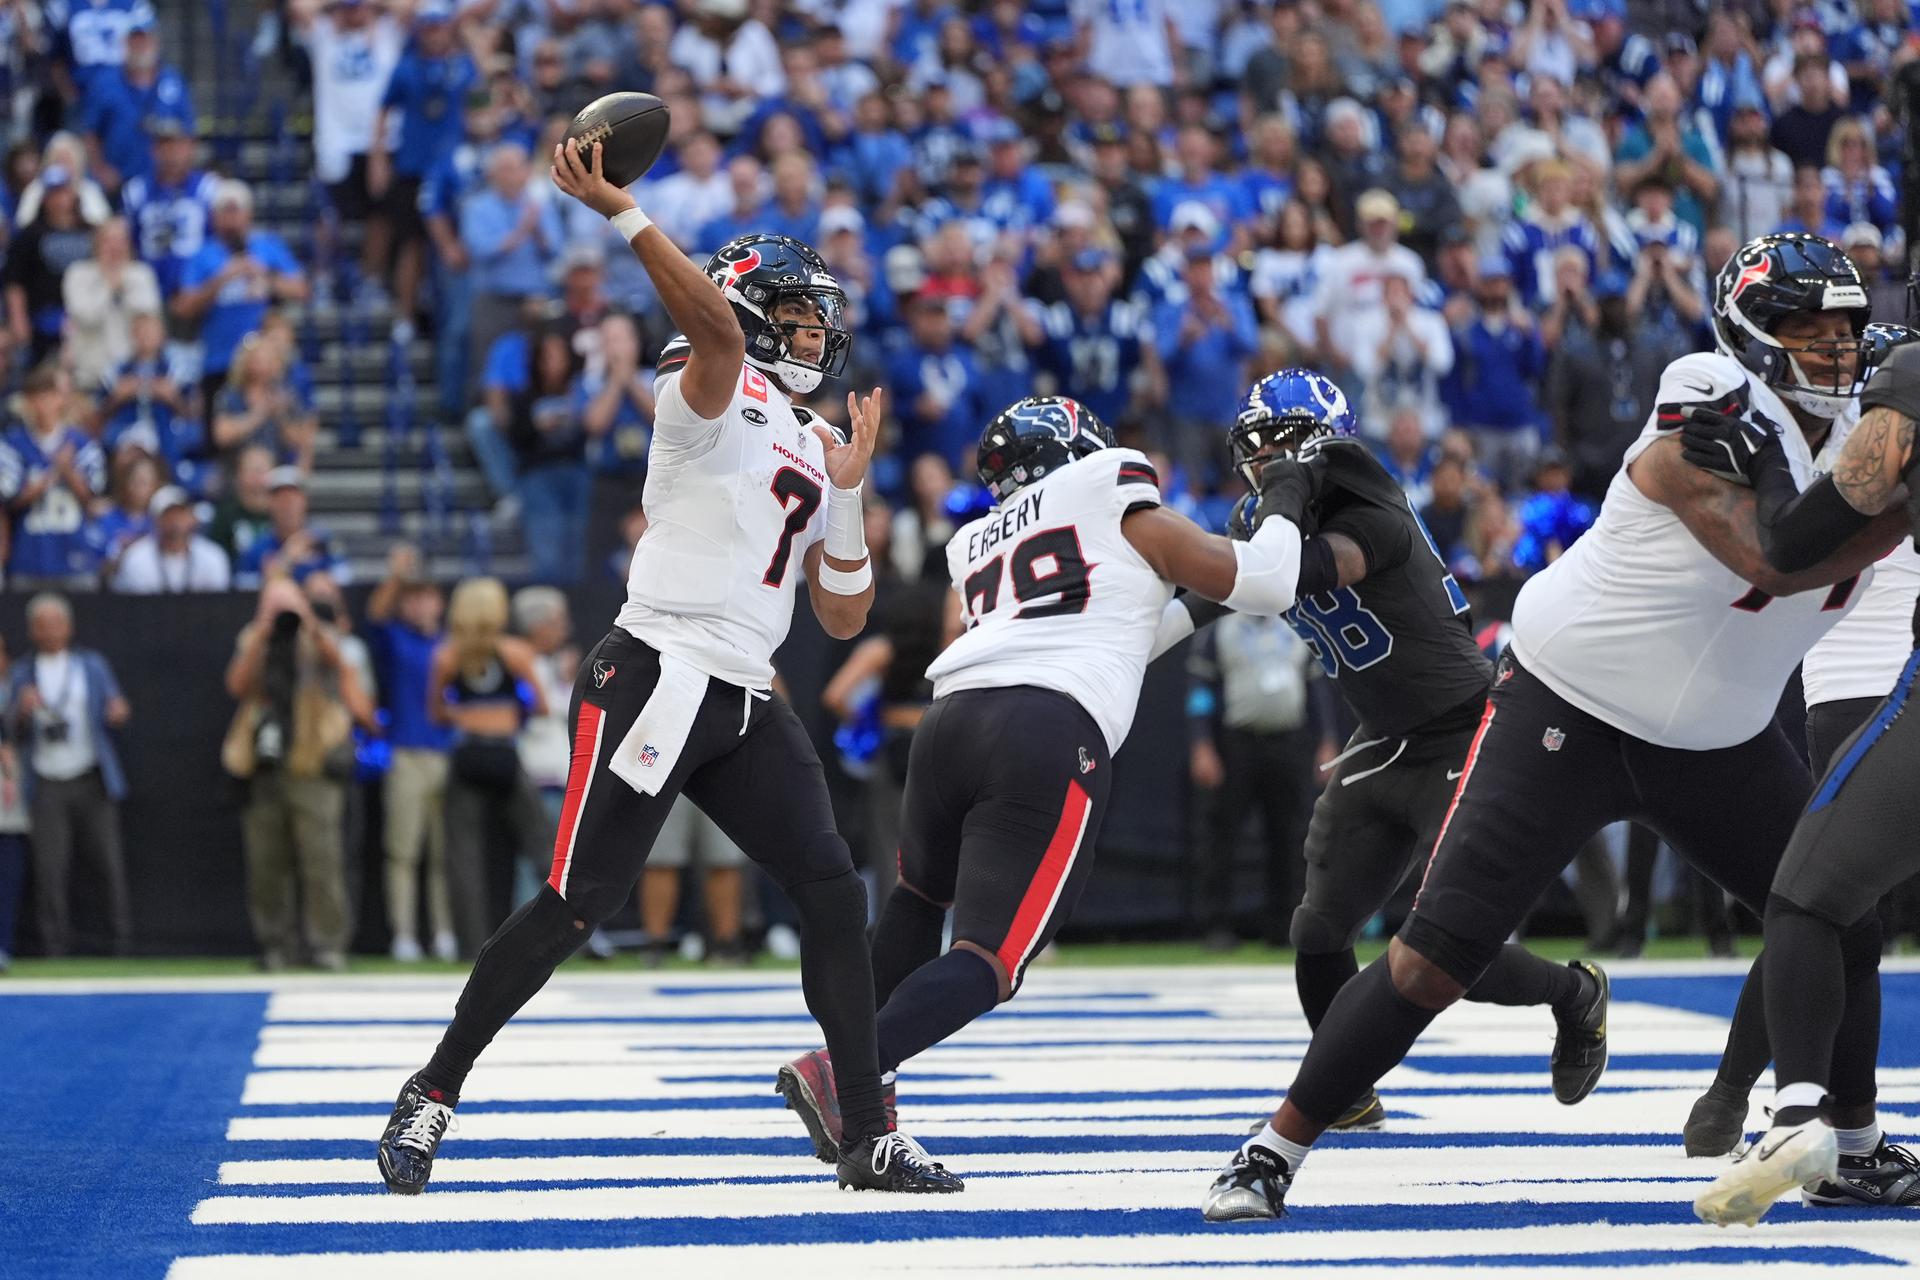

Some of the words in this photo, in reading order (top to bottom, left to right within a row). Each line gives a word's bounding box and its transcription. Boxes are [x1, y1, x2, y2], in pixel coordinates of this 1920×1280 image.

[746, 369, 766, 393] C
[772, 442, 825, 482] HOUSTON
[762, 465, 823, 588] 7
[968, 488, 1044, 564] ERSERY
[964, 524, 1103, 629] 79
[1848, 1178, 1881, 1195] ALPHA
